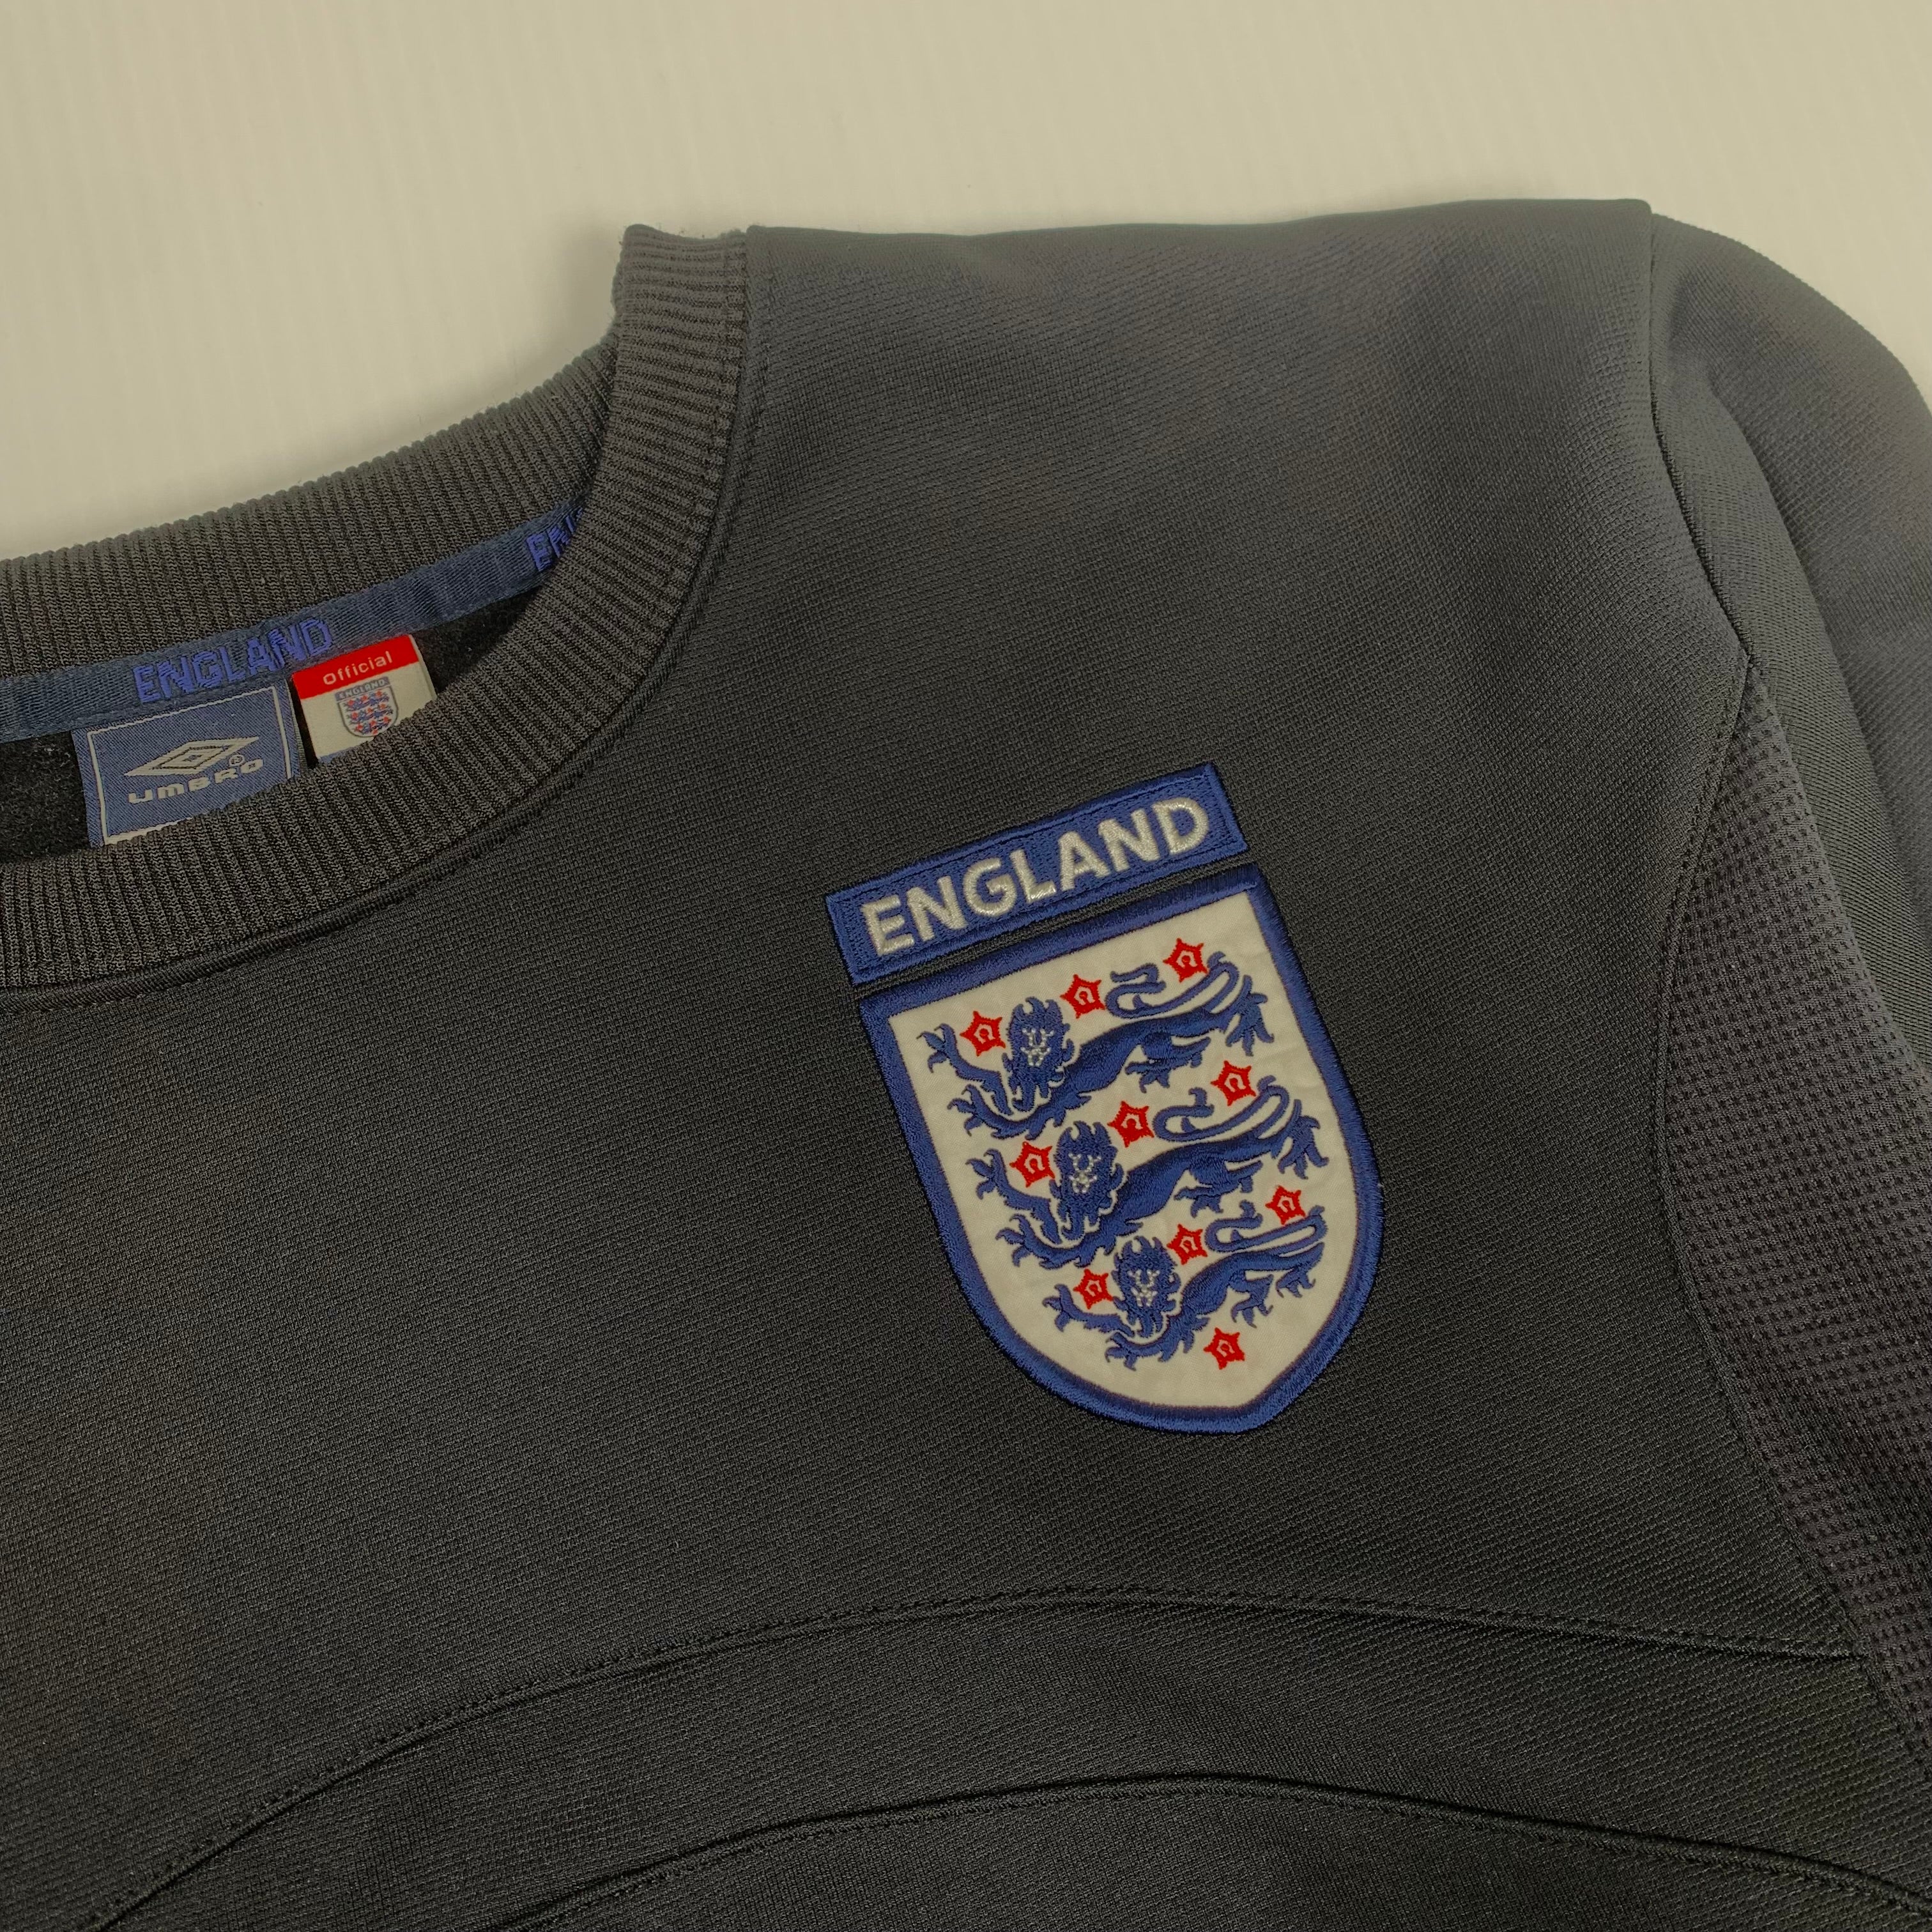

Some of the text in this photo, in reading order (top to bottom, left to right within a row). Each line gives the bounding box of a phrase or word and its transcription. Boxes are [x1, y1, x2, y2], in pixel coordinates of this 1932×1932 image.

[133, 618, 333, 703] ENGLAND
[323, 650, 393, 685] Official
[339, 678, 385, 699] ENGLAND
[862, 797, 1209, 956] ENGLAND
